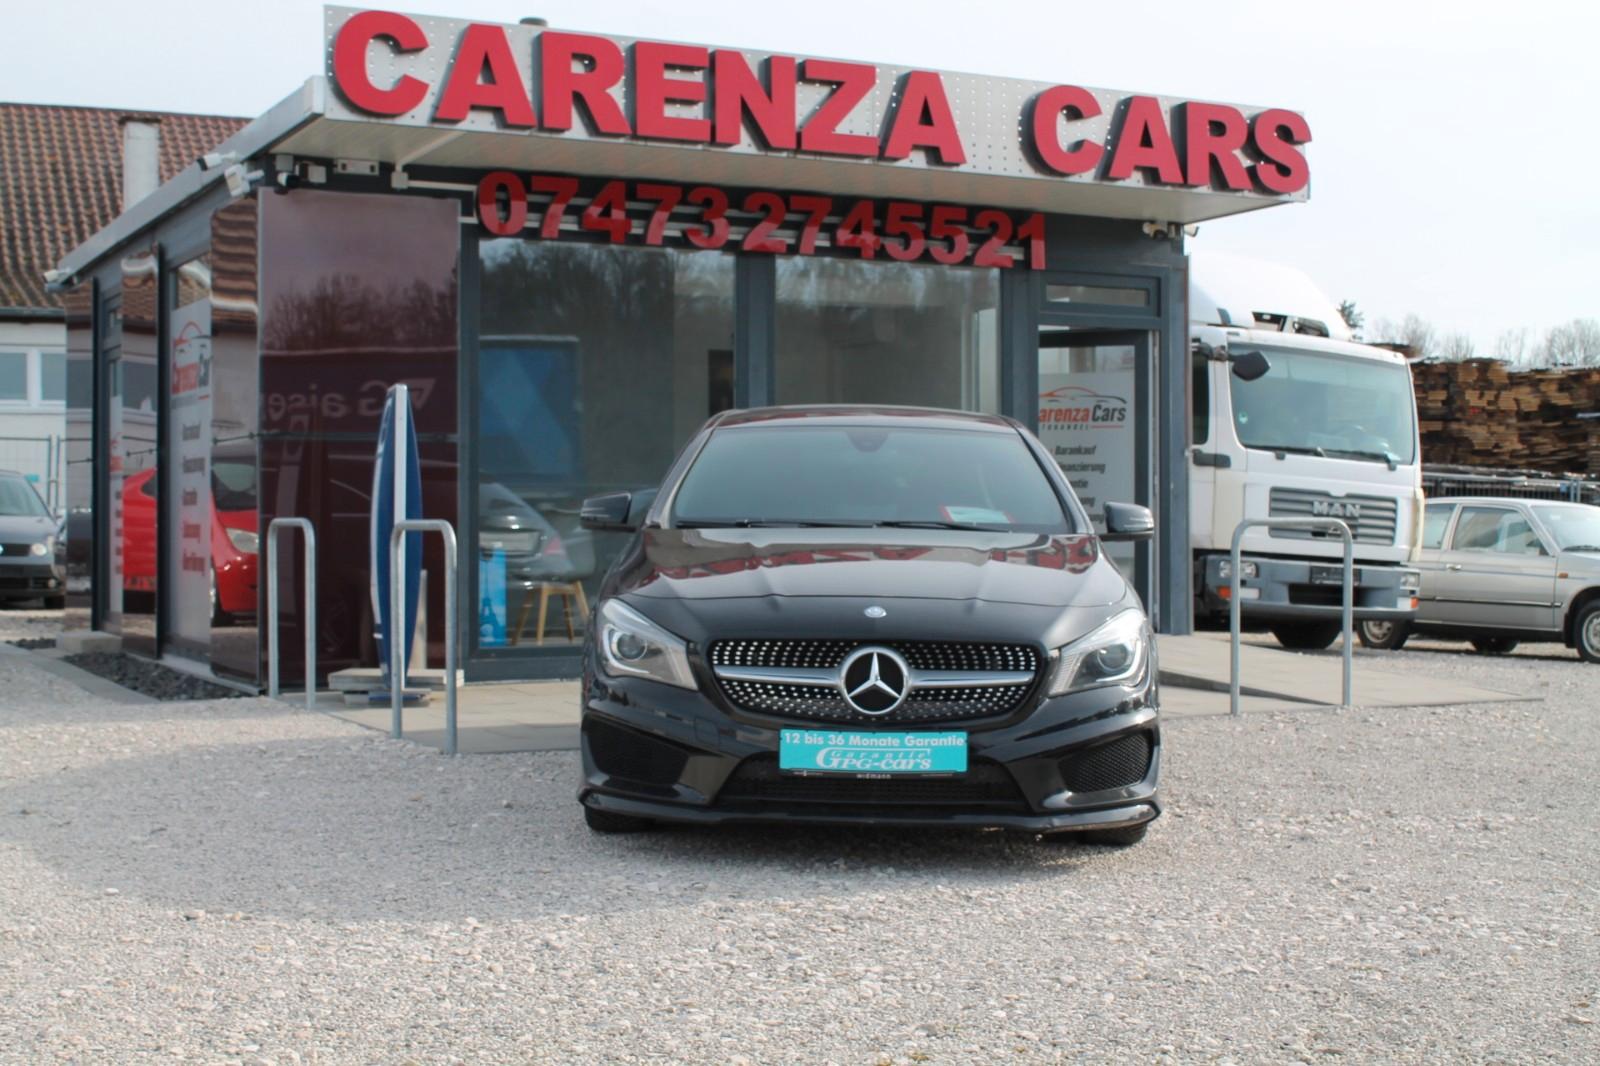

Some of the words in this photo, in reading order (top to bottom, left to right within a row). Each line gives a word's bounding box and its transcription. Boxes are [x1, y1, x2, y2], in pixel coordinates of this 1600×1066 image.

[332, 10, 966, 166] CARENZA
[1033, 84, 1312, 194] CARS
[1312, 500, 1360, 518] MAN
[784, 732, 801, 744] 12
[804, 732, 824, 745] bis
[827, 734, 846, 746] 36
[848, 735, 901, 747] Monate
[904, 735, 964, 747] Garantie
